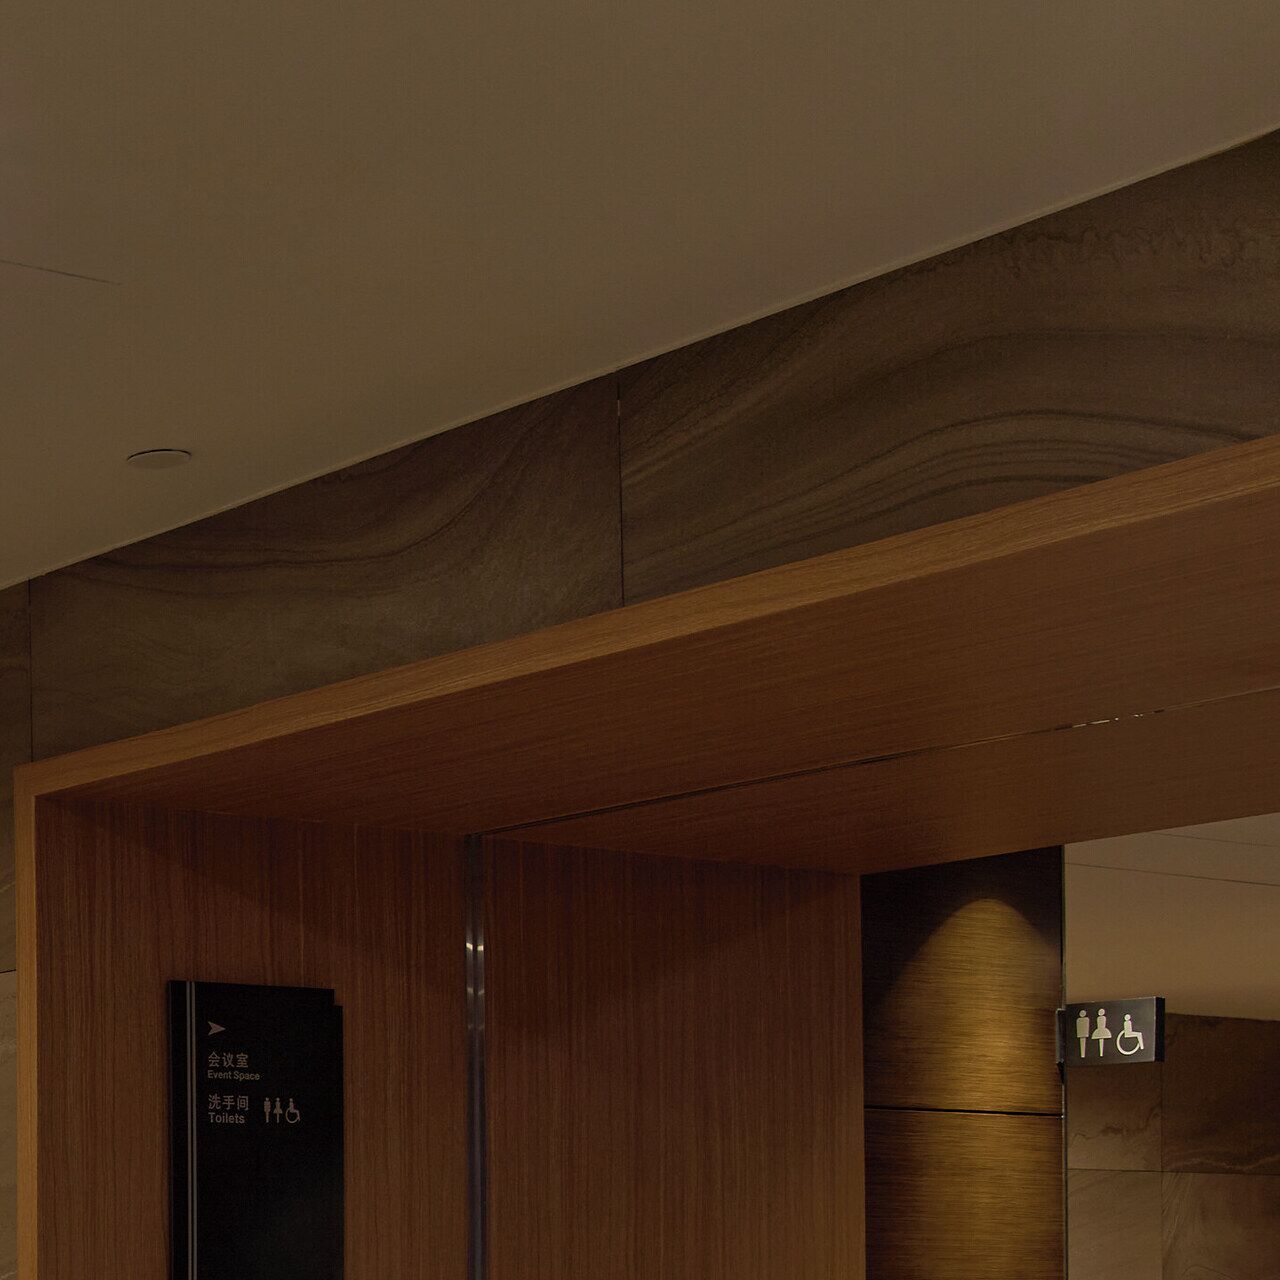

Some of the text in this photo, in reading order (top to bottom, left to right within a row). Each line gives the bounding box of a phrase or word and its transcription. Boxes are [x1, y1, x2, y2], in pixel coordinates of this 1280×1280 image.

[208, 1051, 249, 1068] 会议室
[207, 1070, 260, 1082] Event Space
[208, 1093, 249, 1111] 洗手间
[208, 1112, 245, 1123] Toilets
